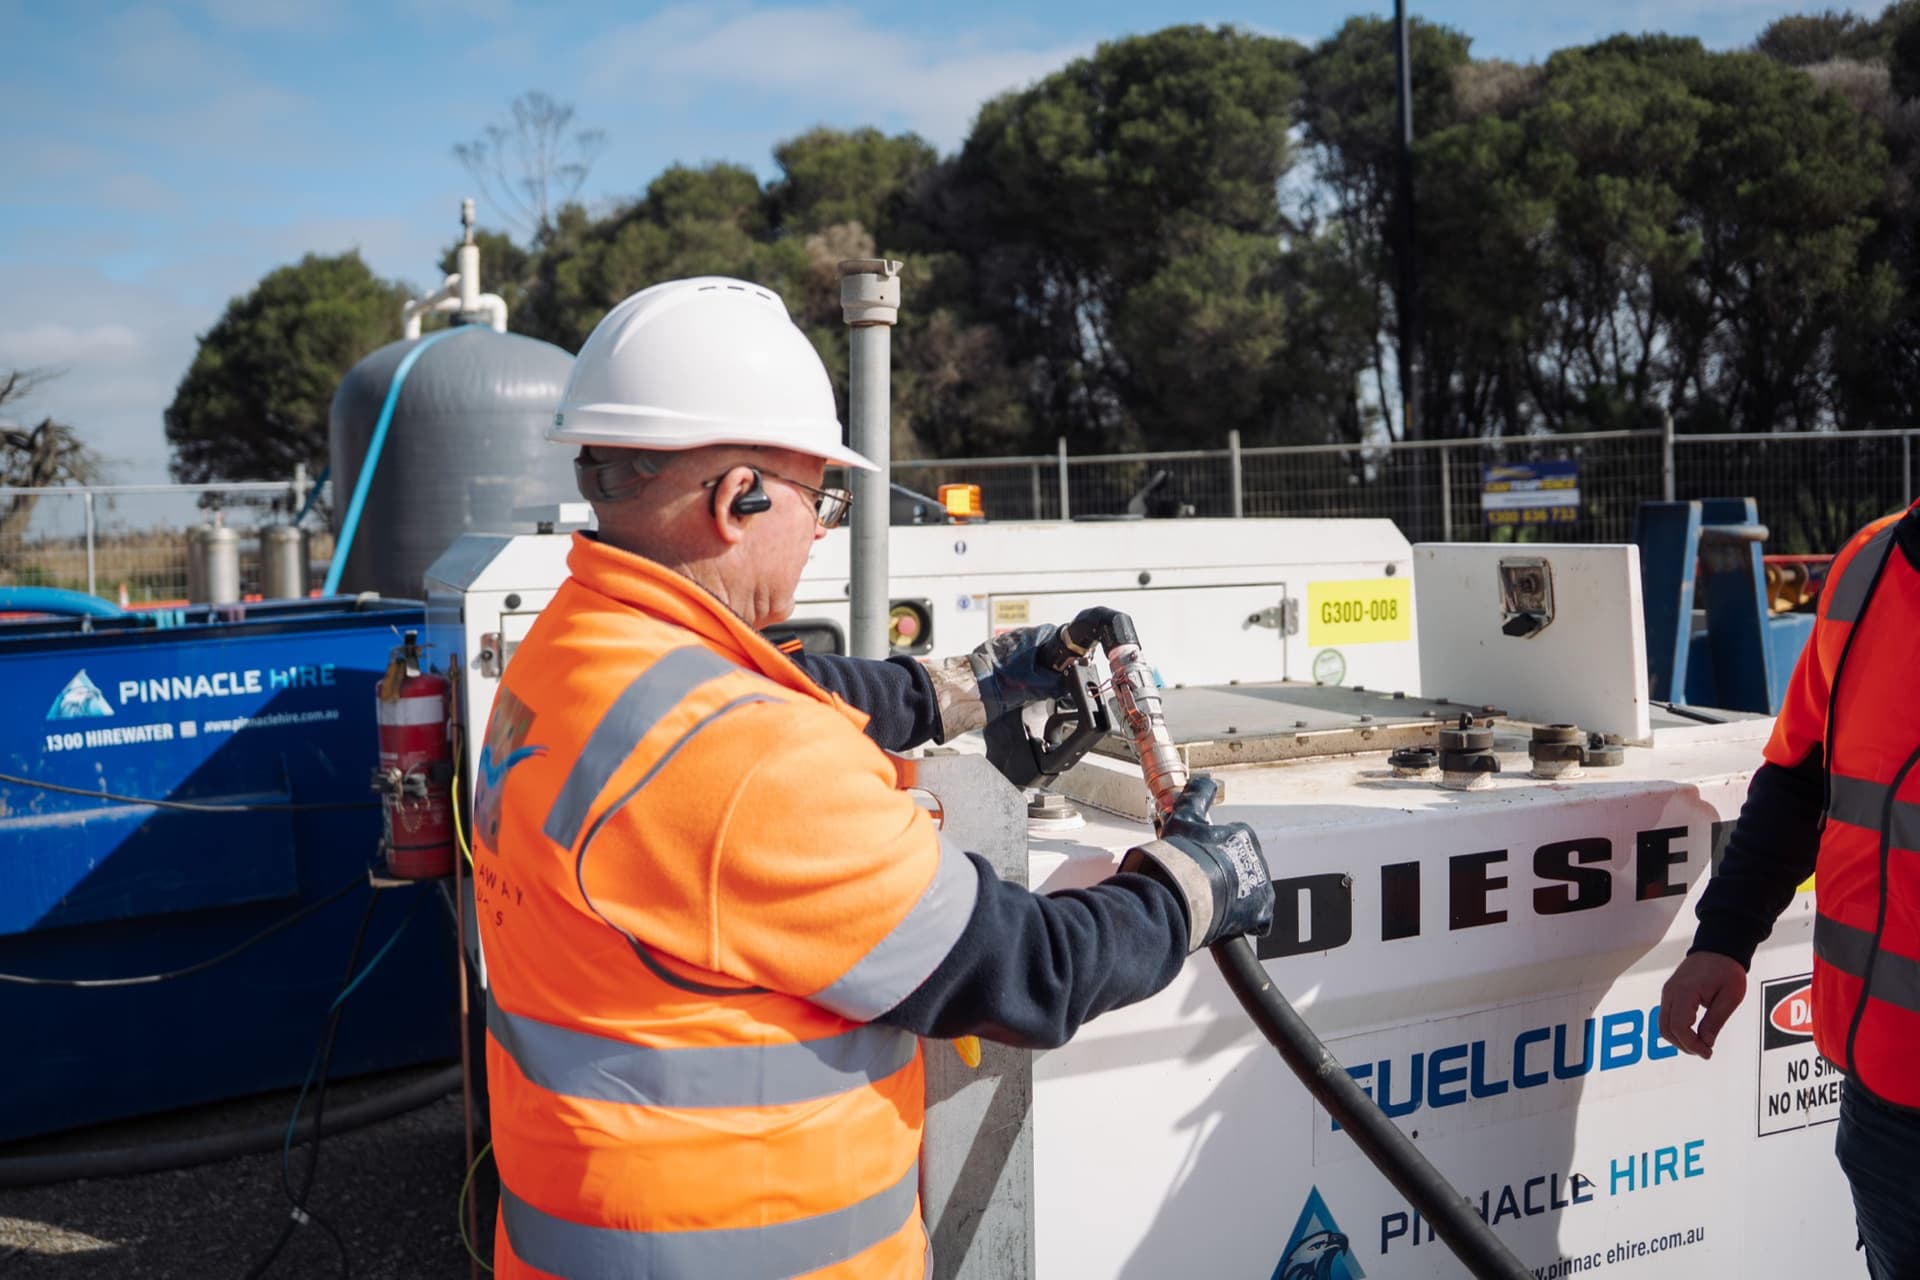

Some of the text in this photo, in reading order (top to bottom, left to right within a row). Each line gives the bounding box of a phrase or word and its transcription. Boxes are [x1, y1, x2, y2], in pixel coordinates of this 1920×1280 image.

[1322, 598, 1397, 624] G30D-008
[119, 663, 336, 705] PINNACLE HIRE
[46, 732, 83, 752] 1300
[85, 723, 174, 748] HIREWATER
[1788, 1059, 1809, 1083] NO
[1768, 1091, 1791, 1117] NO
[1610, 1139, 1705, 1196] HIRE
